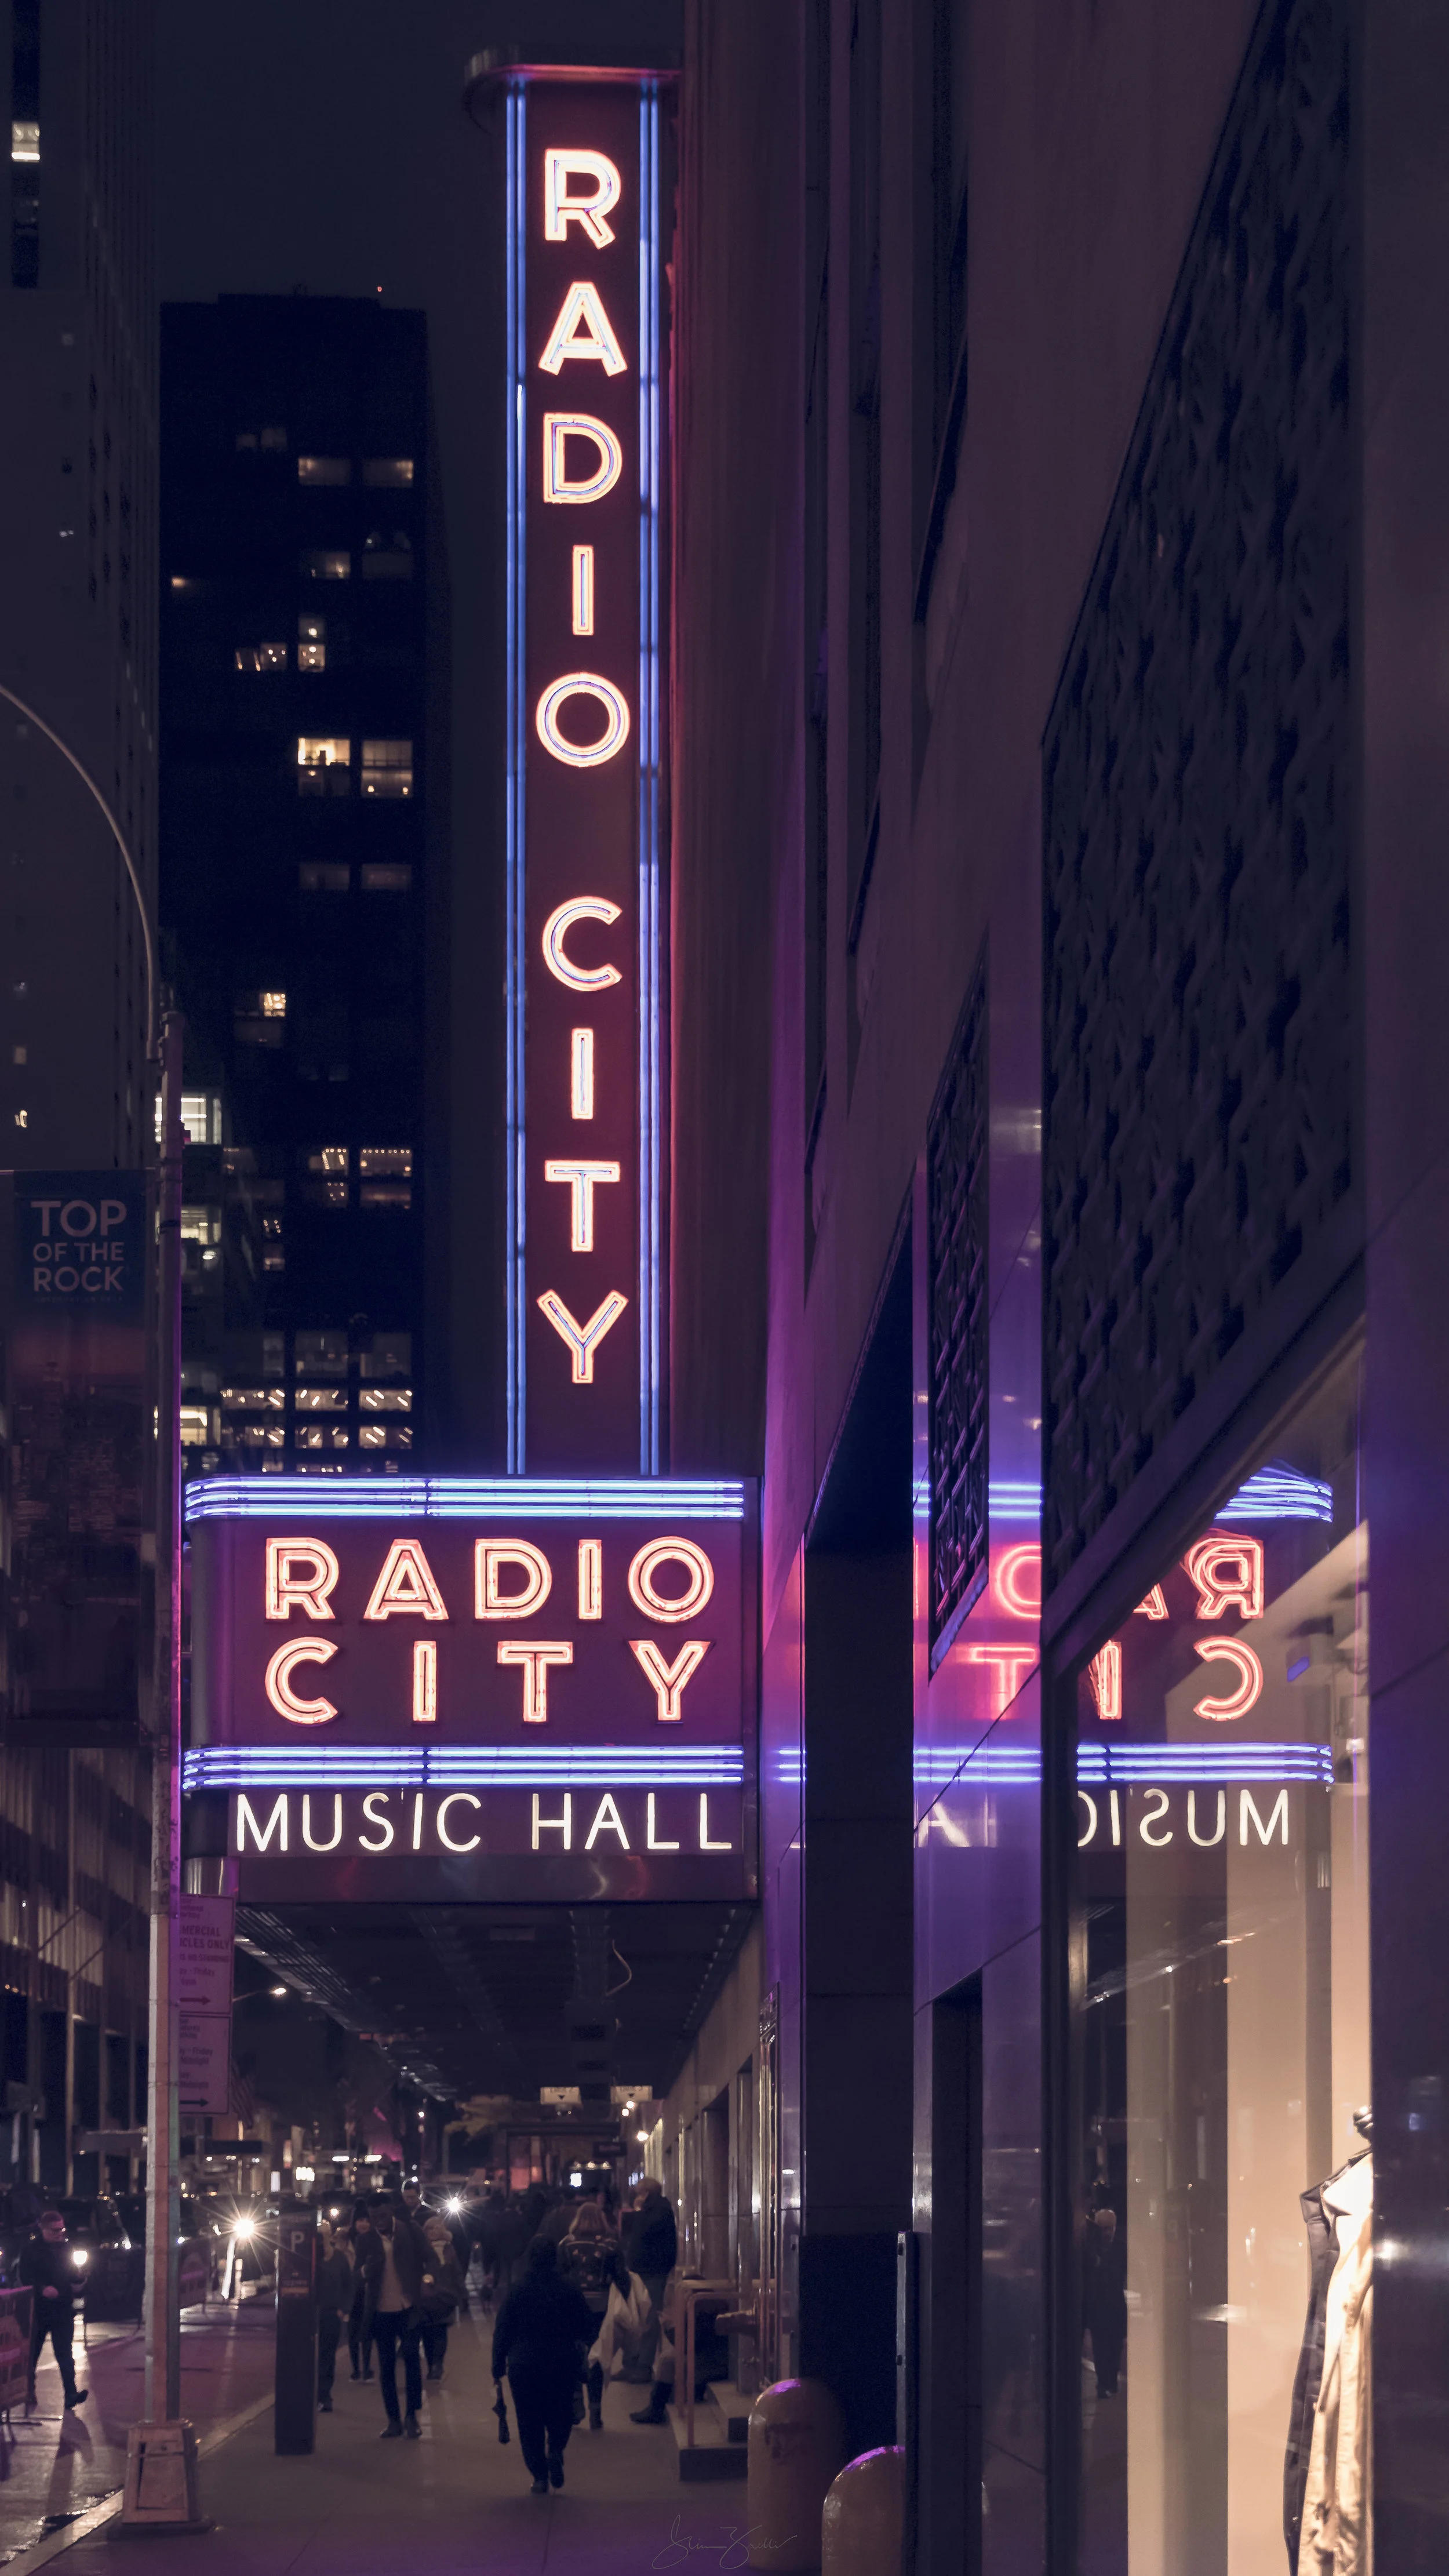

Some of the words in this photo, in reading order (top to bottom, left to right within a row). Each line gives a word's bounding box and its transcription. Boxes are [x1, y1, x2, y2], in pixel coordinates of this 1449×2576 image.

[536, 148, 630, 767] RADIO
[536, 896, 629, 1384] CITY
[31, 1200, 126, 1237] TOP
[33, 1243, 67, 1262] OF
[74, 1242, 124, 1261] THE
[33, 1266, 123, 1291] ROCK
[265, 1536, 714, 1623] RADIO
[264, 1636, 711, 1724] CITY
[236, 1792, 482, 1851] MUSIC
[531, 1792, 732, 1850] HALL
[180, 1938, 205, 1948] ICLES
[207, 1939, 230, 1949] ONLY
[181, 1925, 221, 1937] MERCIAL
[291, 2231, 305, 2252] P
